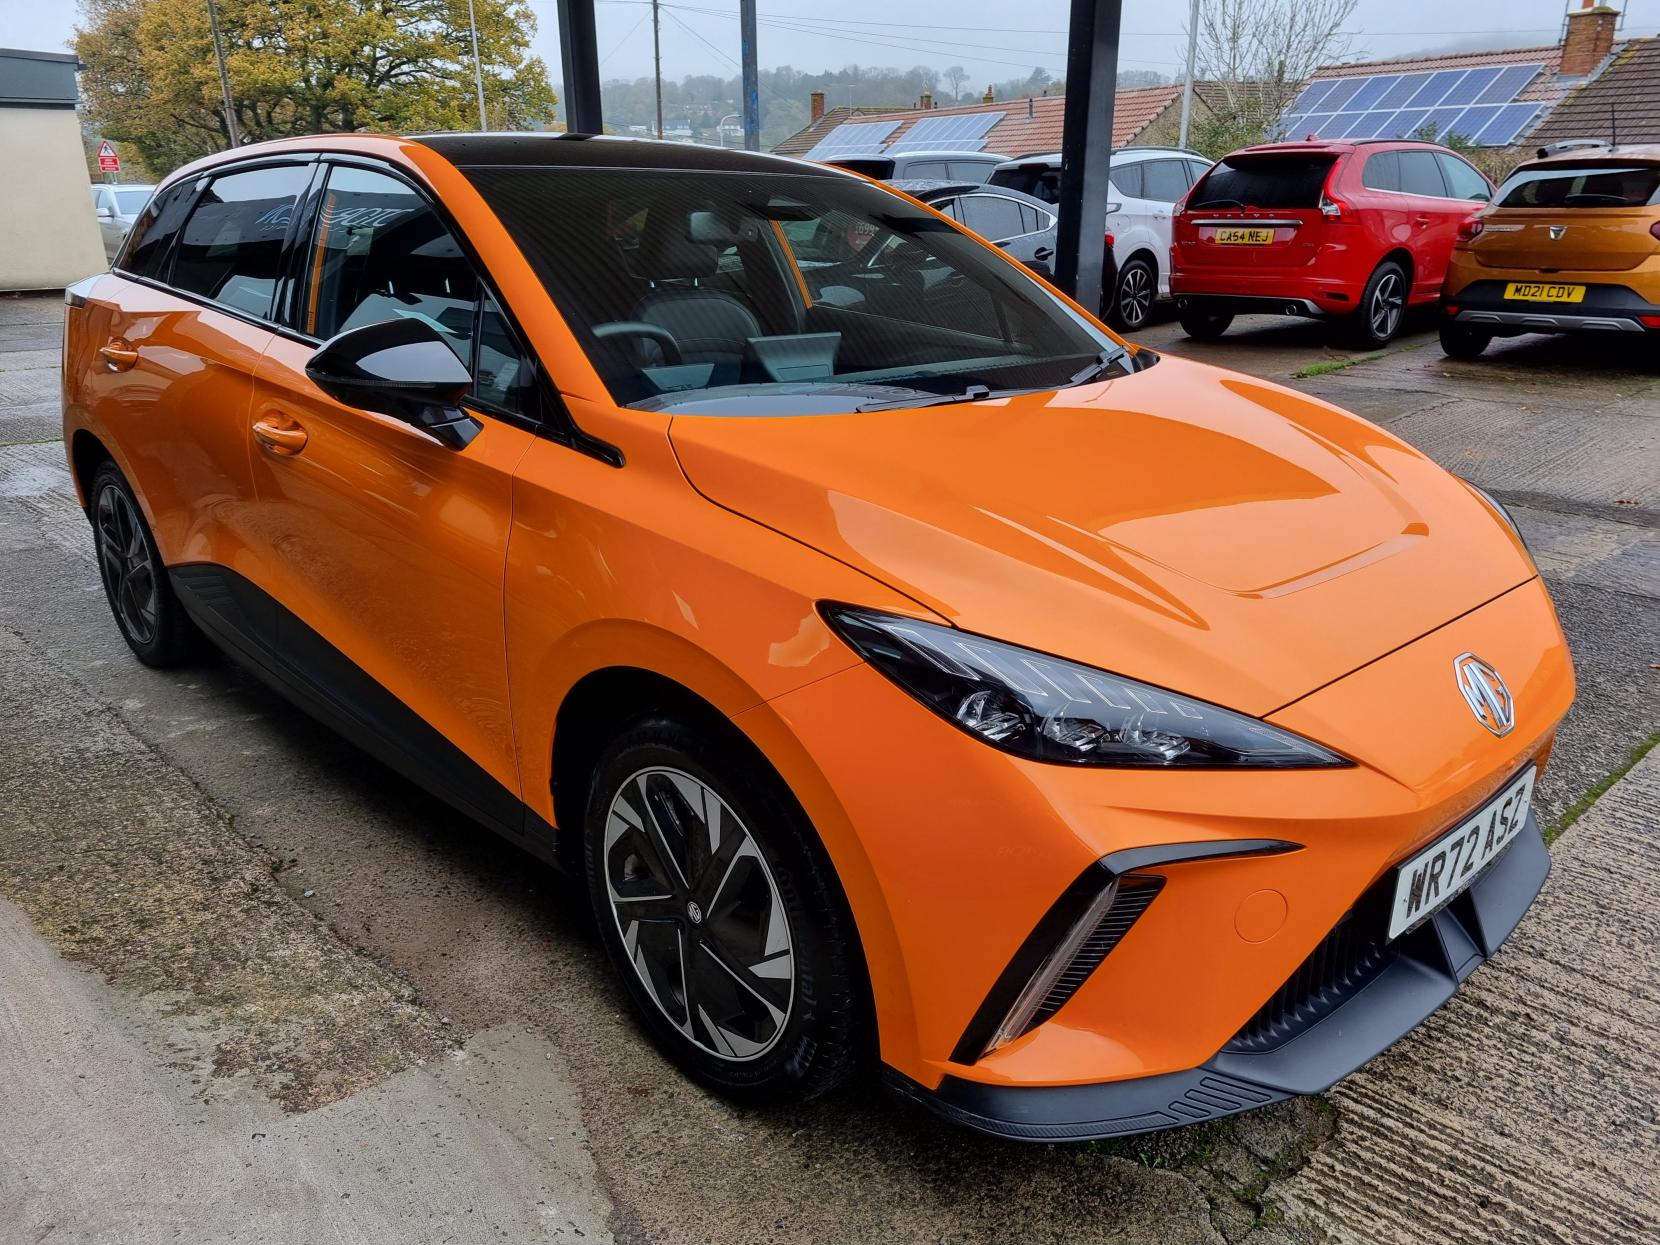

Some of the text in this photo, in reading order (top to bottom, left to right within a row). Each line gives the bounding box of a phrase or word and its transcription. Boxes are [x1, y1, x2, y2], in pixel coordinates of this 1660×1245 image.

[1247, 230, 1269, 242] NEJ
[1513, 284, 1576, 298] MD21 CDV
[1458, 656, 1511, 733] MG
[1406, 783, 1526, 919] WR72 ASZ
